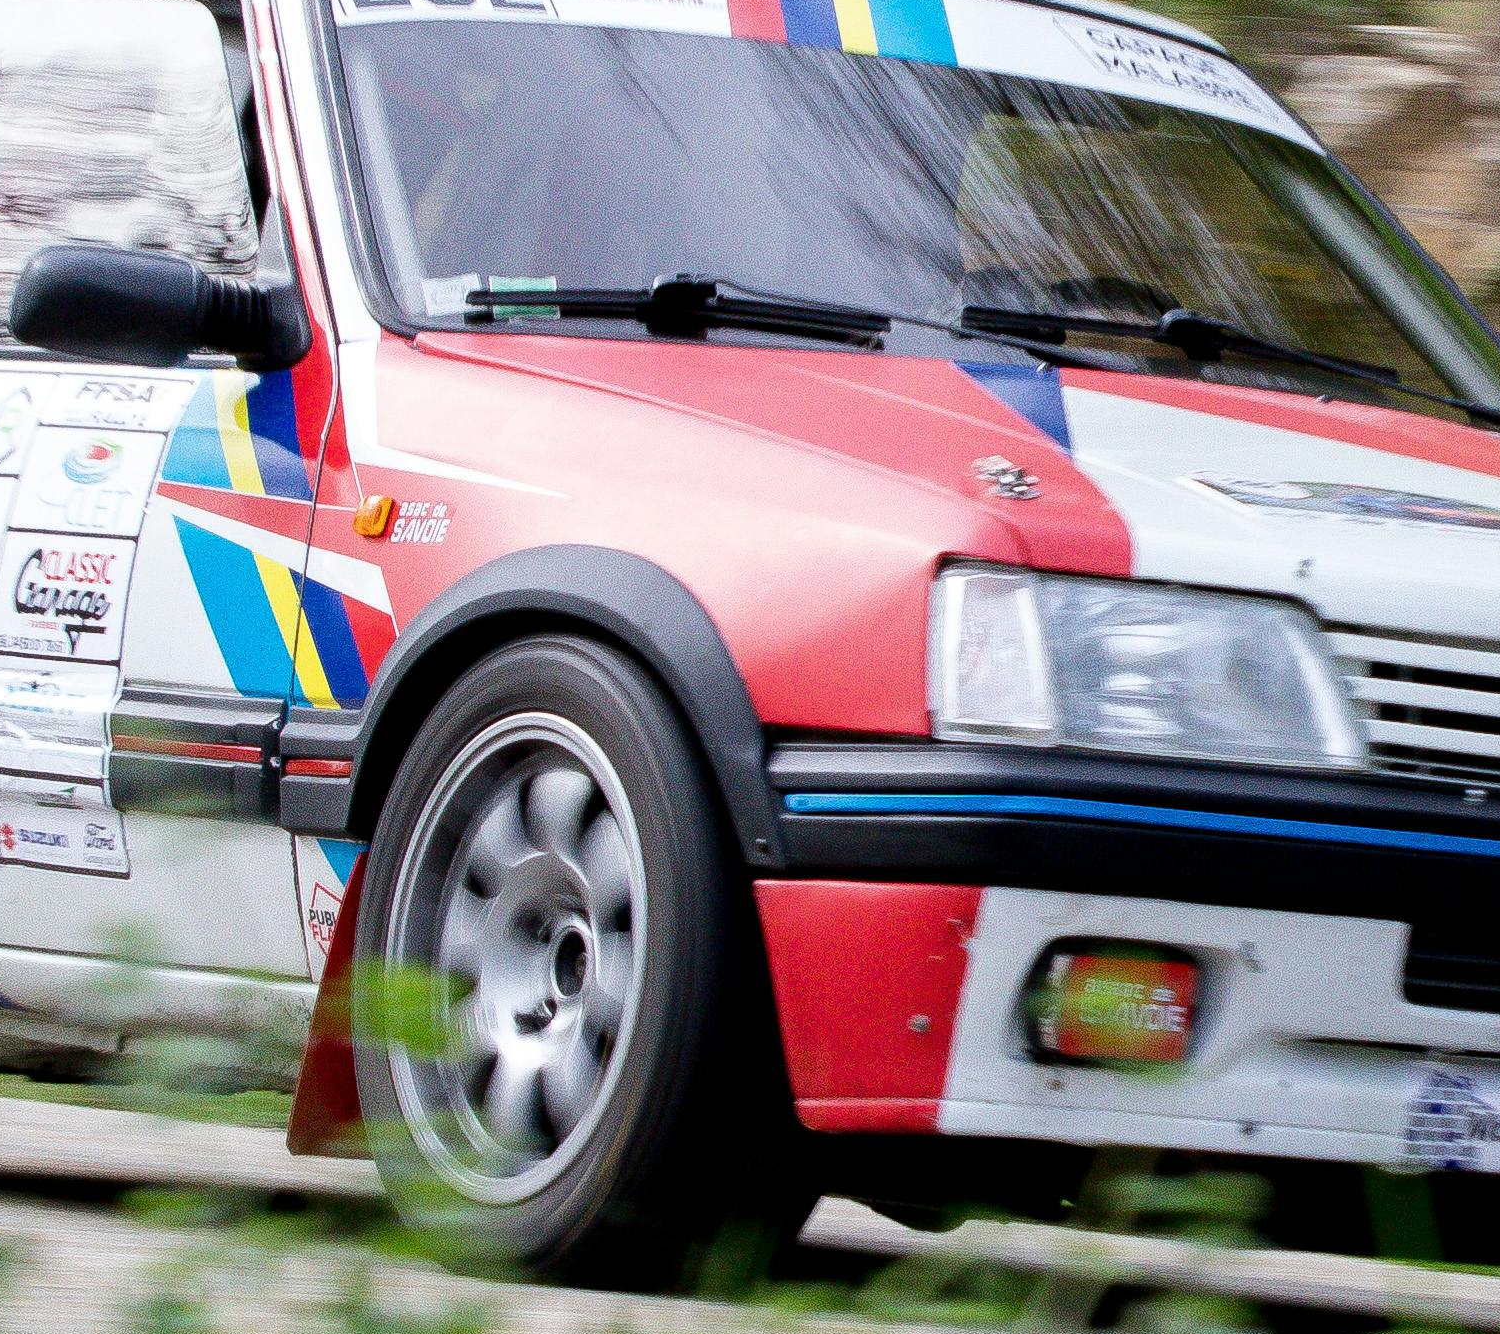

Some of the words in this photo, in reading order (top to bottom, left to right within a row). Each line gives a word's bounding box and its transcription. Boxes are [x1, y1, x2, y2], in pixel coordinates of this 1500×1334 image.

[390, 518, 452, 543] SAVOIE
[42, 549, 118, 585] CLASSIC
[18, 828, 70, 848] SUZUKI
